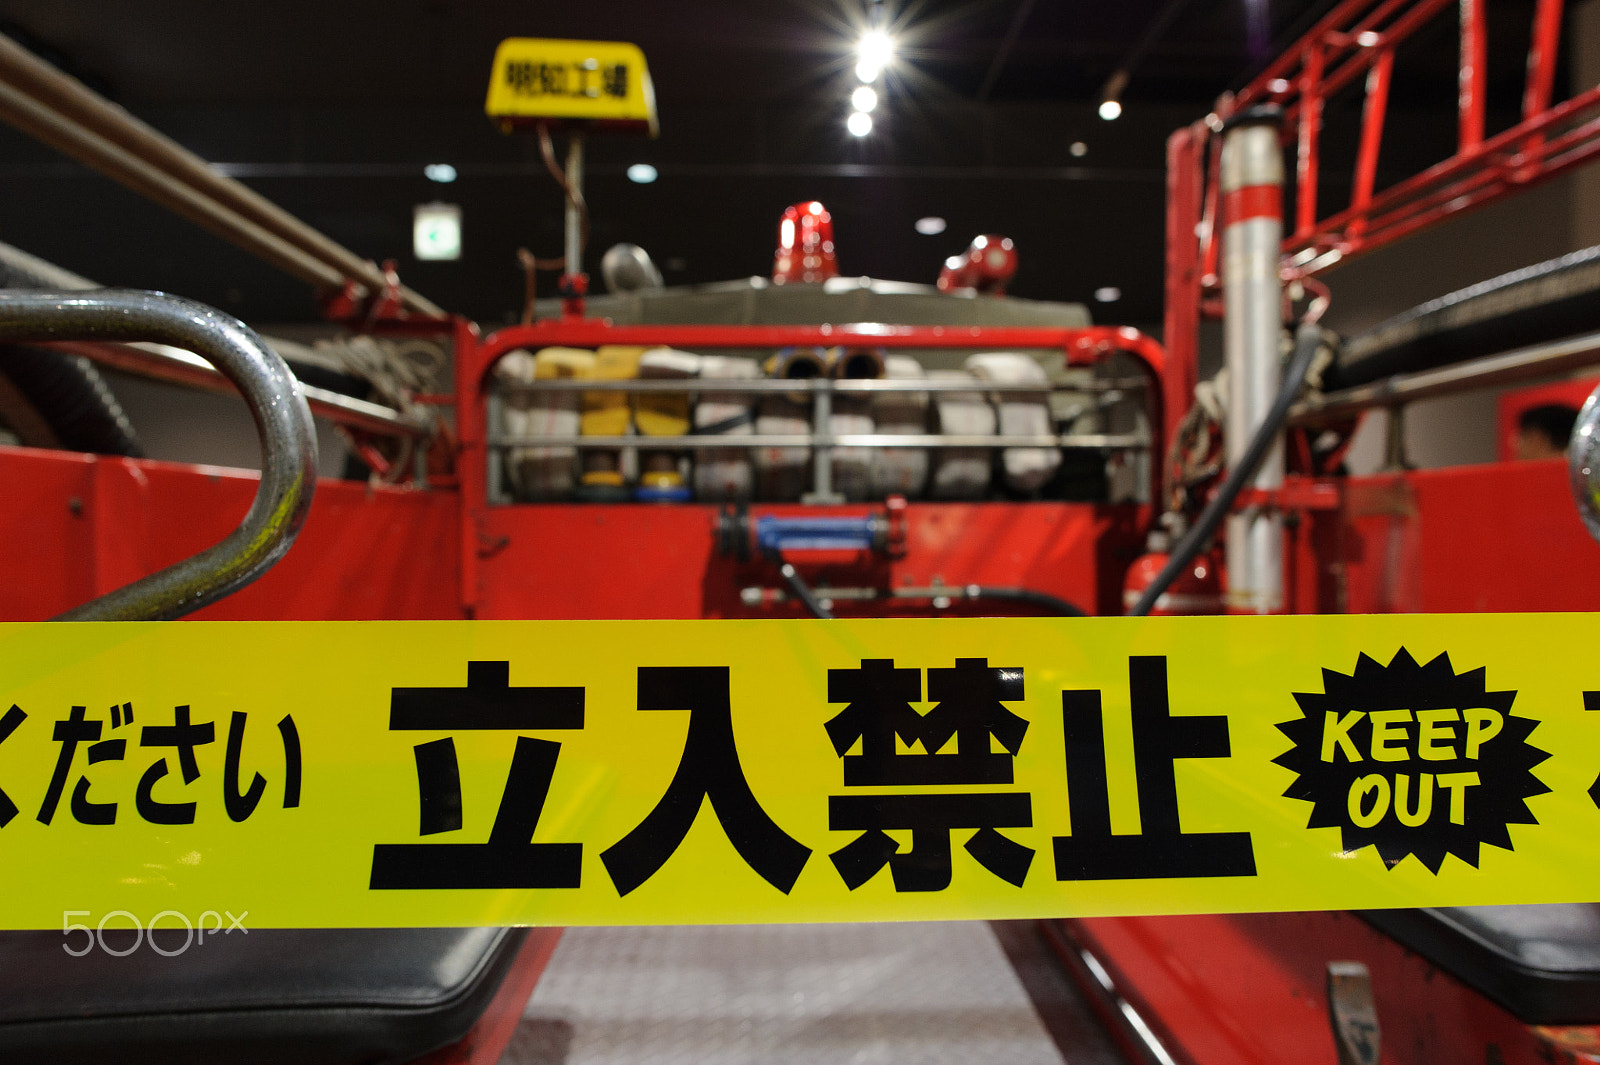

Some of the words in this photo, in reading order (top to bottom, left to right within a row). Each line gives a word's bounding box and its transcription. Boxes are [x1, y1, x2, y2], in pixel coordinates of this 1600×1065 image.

[1320, 707, 1504, 764] KEEP
[369, 656, 1257, 898] 立入禁止
[1347, 771, 1482, 829] OUT
